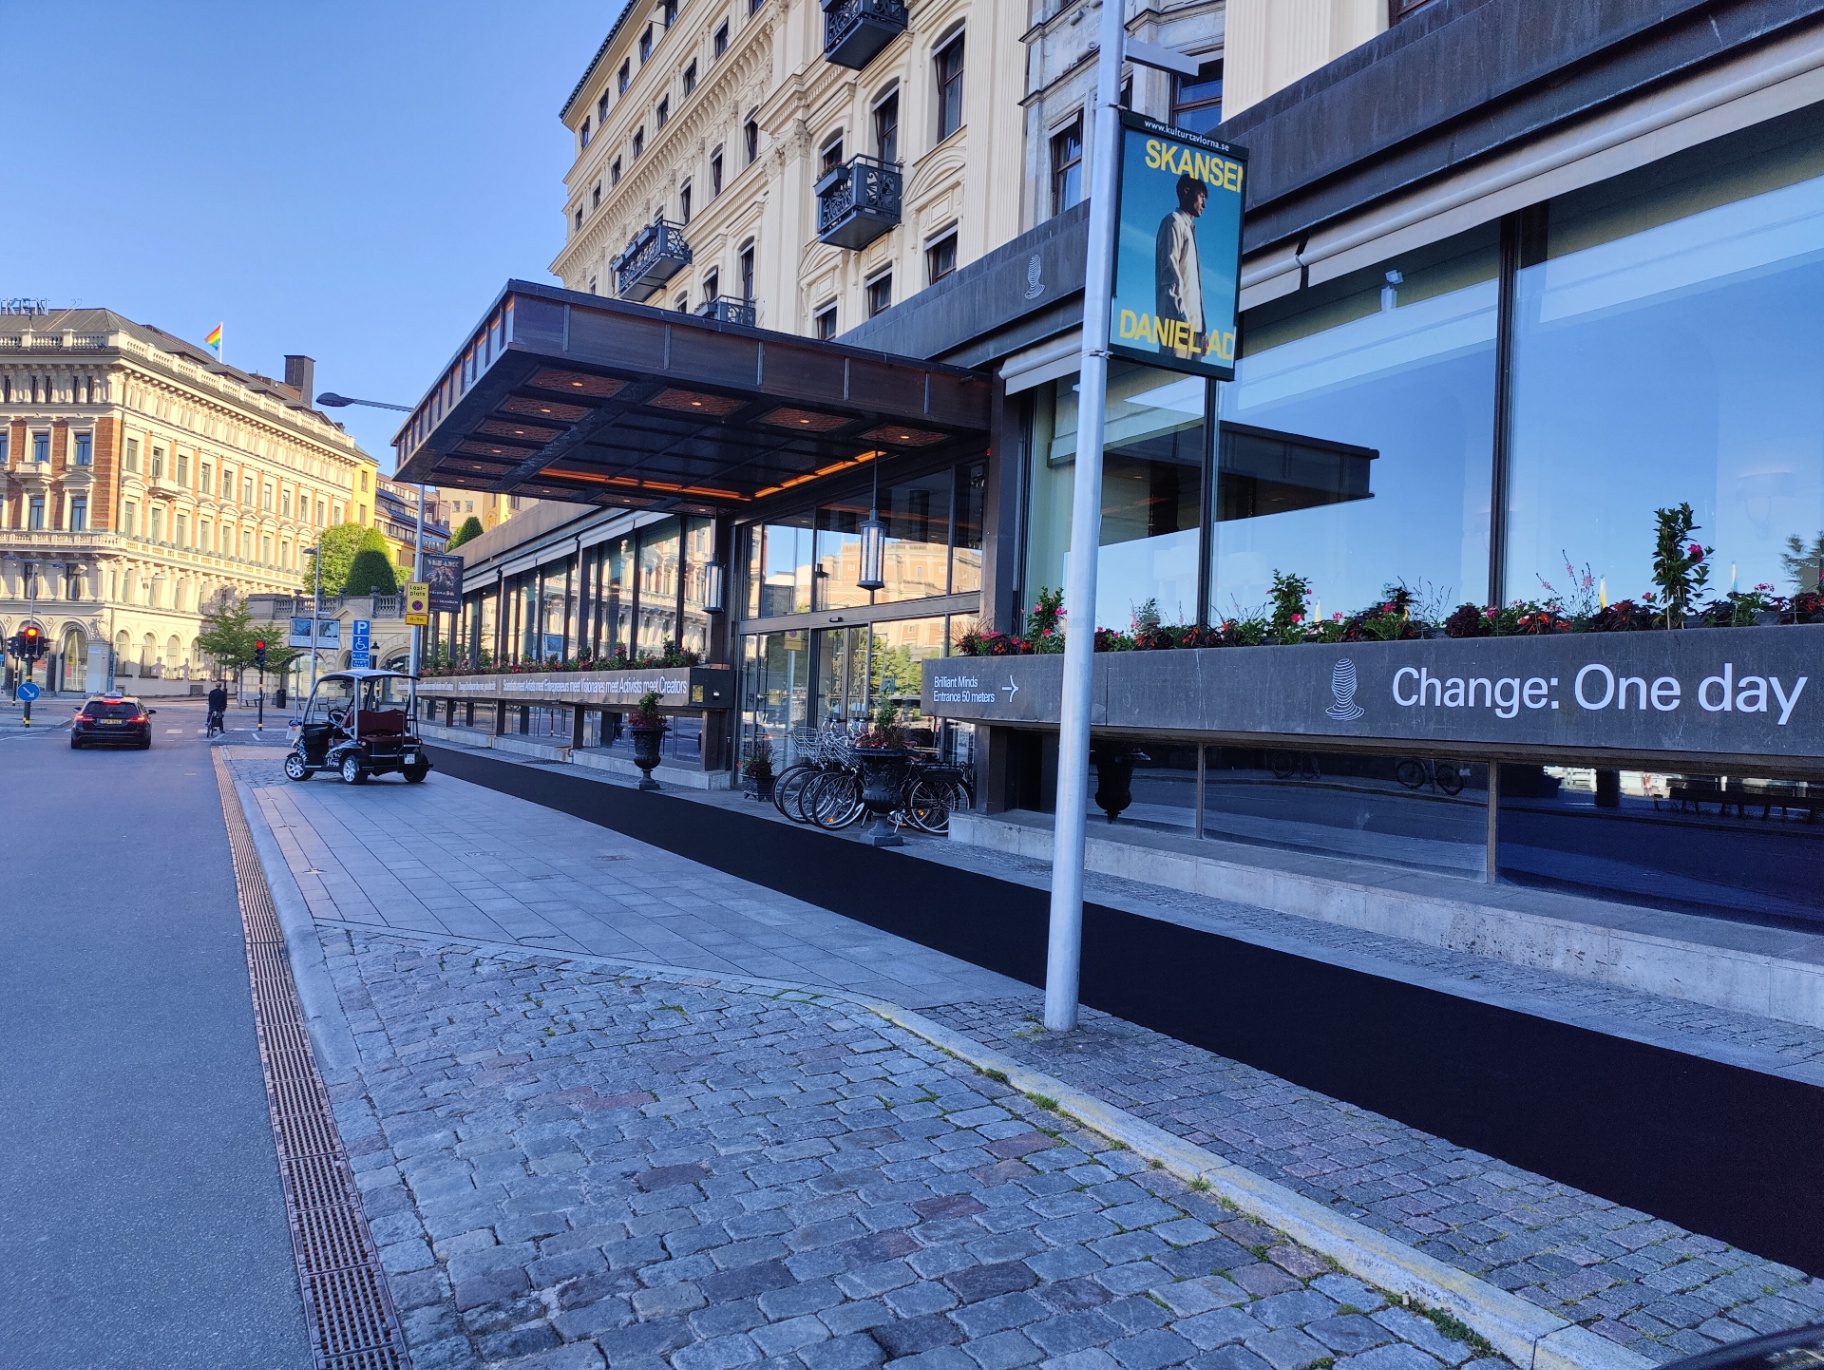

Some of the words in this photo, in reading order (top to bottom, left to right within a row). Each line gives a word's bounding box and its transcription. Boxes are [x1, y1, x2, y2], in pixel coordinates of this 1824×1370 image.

[1144, 120, 1230, 152] www.kulturtavlorna.se
[0, 297, 49, 316] KEN
[1119, 308, 1202, 354] DANIEL
[606, 680, 619, 694] meet
[619, 677, 642, 694] Activists
[643, 679, 658, 694] meet
[660, 676, 687, 694] Creators
[934, 676, 957, 688] Brilliant
[958, 676, 979, 688] Minds
[933, 690, 961, 702] Entrance
[961, 690, 971, 703] 50
[971, 691, 996, 703] meters
[1392, 666, 1560, 719] Change:
[1574, 663, 1681, 711] One
[1698, 662, 1809, 726] day
